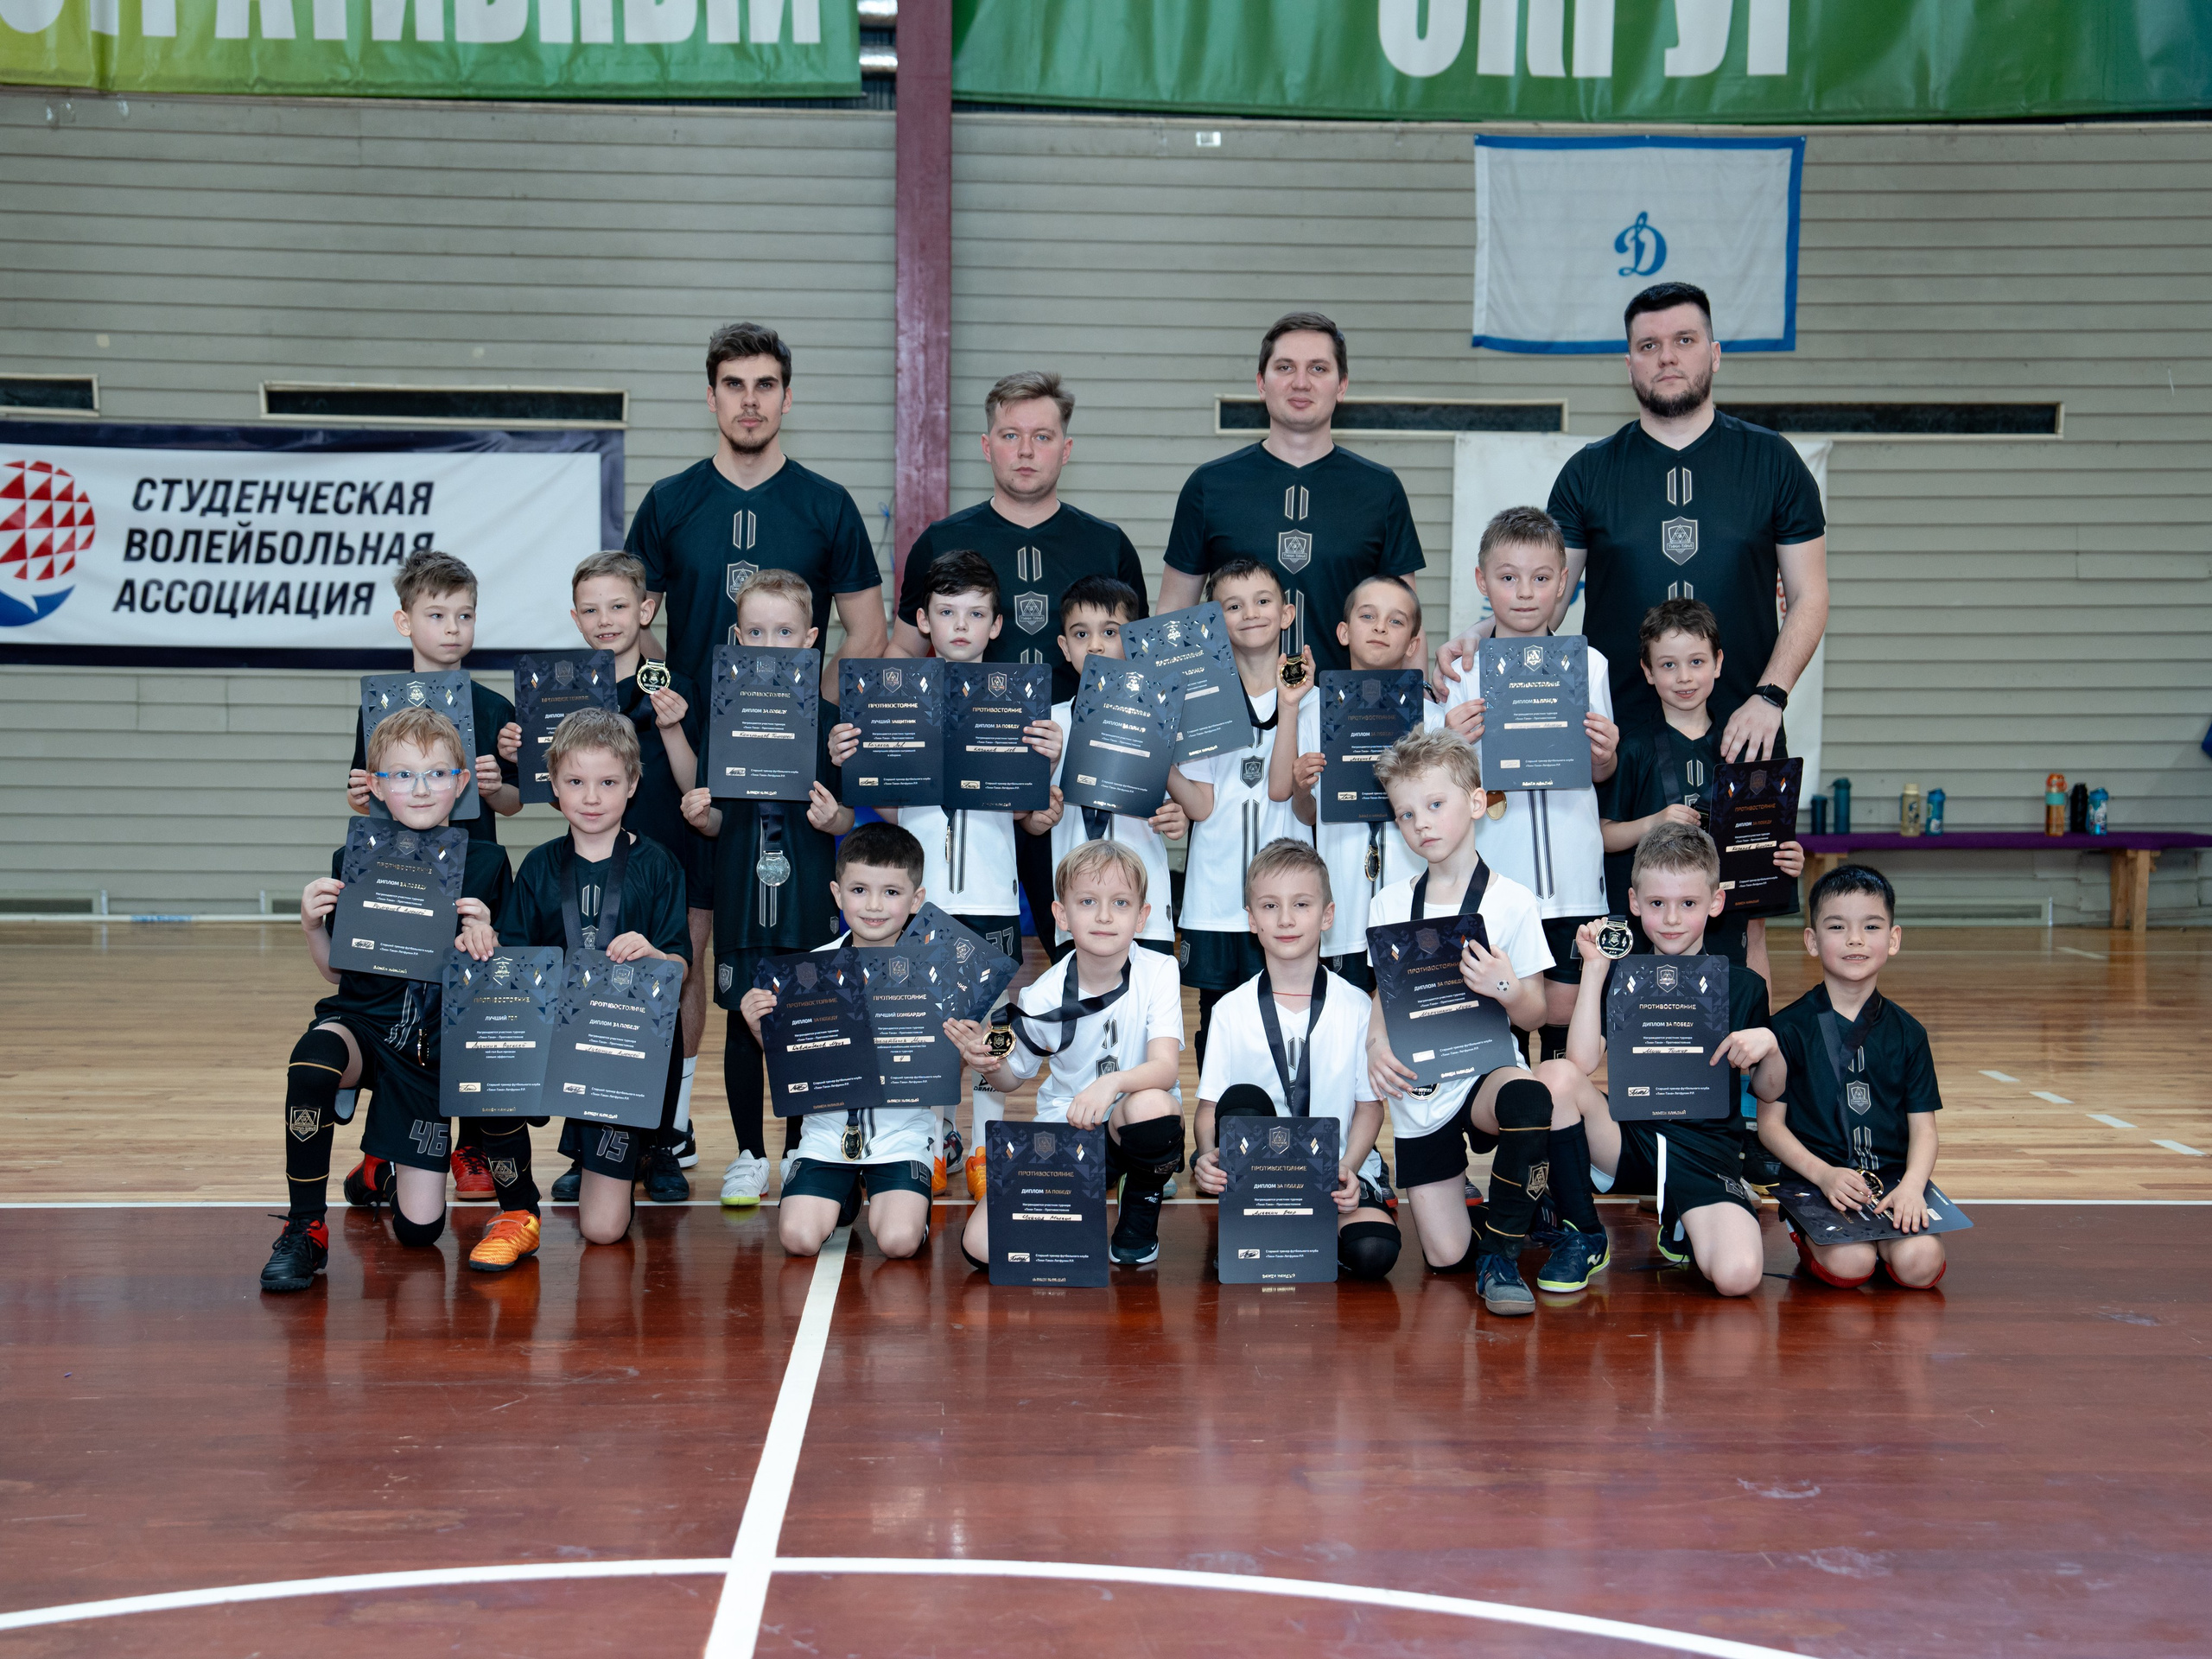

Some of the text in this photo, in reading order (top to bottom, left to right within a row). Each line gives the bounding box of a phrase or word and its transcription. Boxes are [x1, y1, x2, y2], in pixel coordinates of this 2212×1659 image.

[131, 477, 434, 516] СТУДЕНЧЕСКАЯ
[123, 522, 434, 566] ВОЛЕЙБОЛЬНАЯ
[113, 579, 375, 620] АССОЦИАЦИЯ
[1407, 962, 1459, 975] ПРОТИВОСТОЯНИ
[409, 1119, 449, 1157] 46
[596, 1124, 629, 1162] 15
